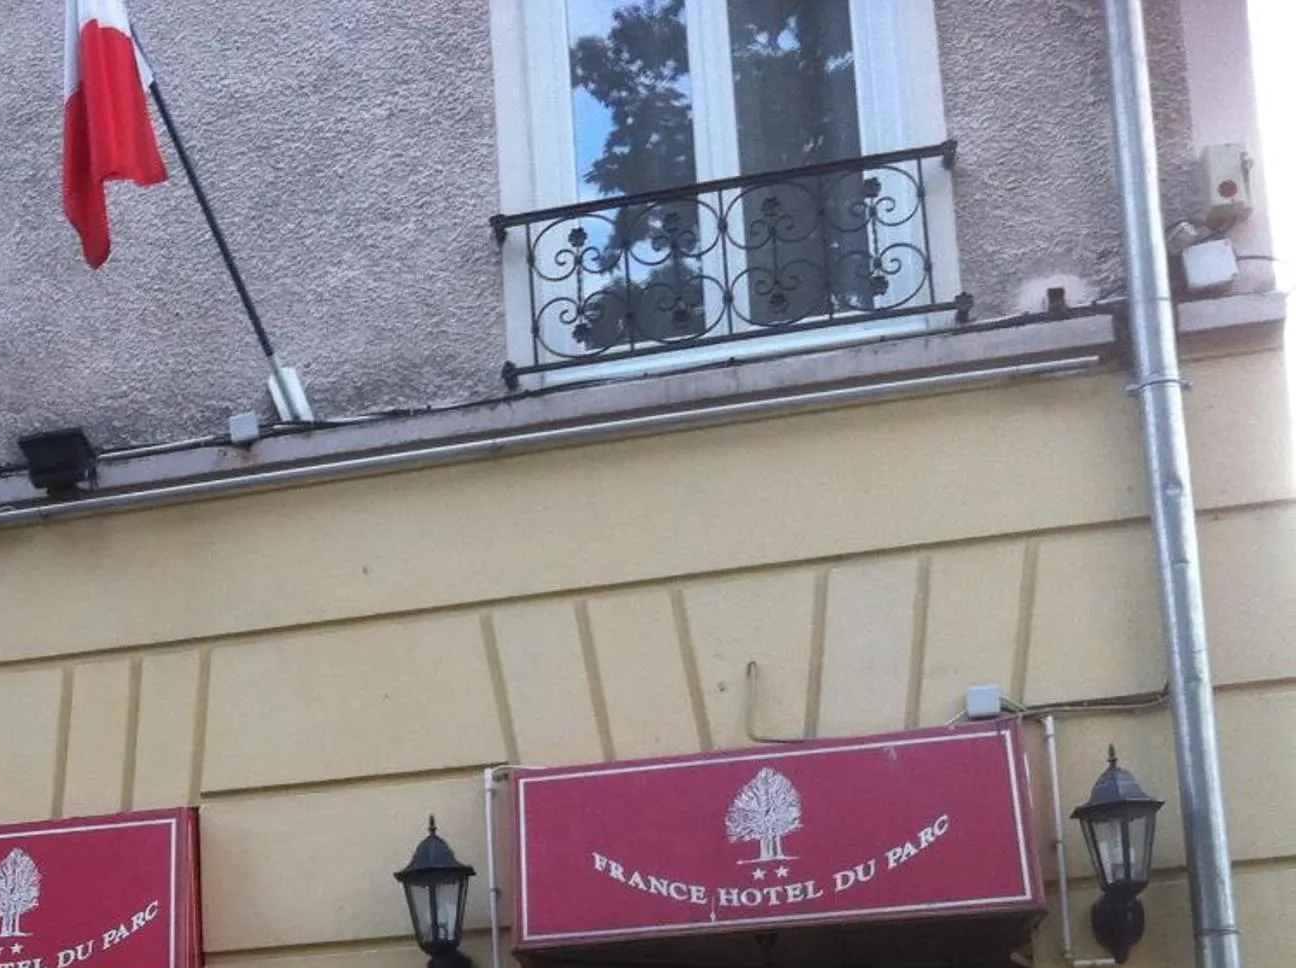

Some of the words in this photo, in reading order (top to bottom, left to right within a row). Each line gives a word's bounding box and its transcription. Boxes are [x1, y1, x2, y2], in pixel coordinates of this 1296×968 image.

[591, 851, 707, 905] FRANCE
[718, 880, 824, 908] HOTEL
[834, 858, 877, 892] DU
[885, 813, 951, 873] PARC
[101, 900, 160, 951] PARC
